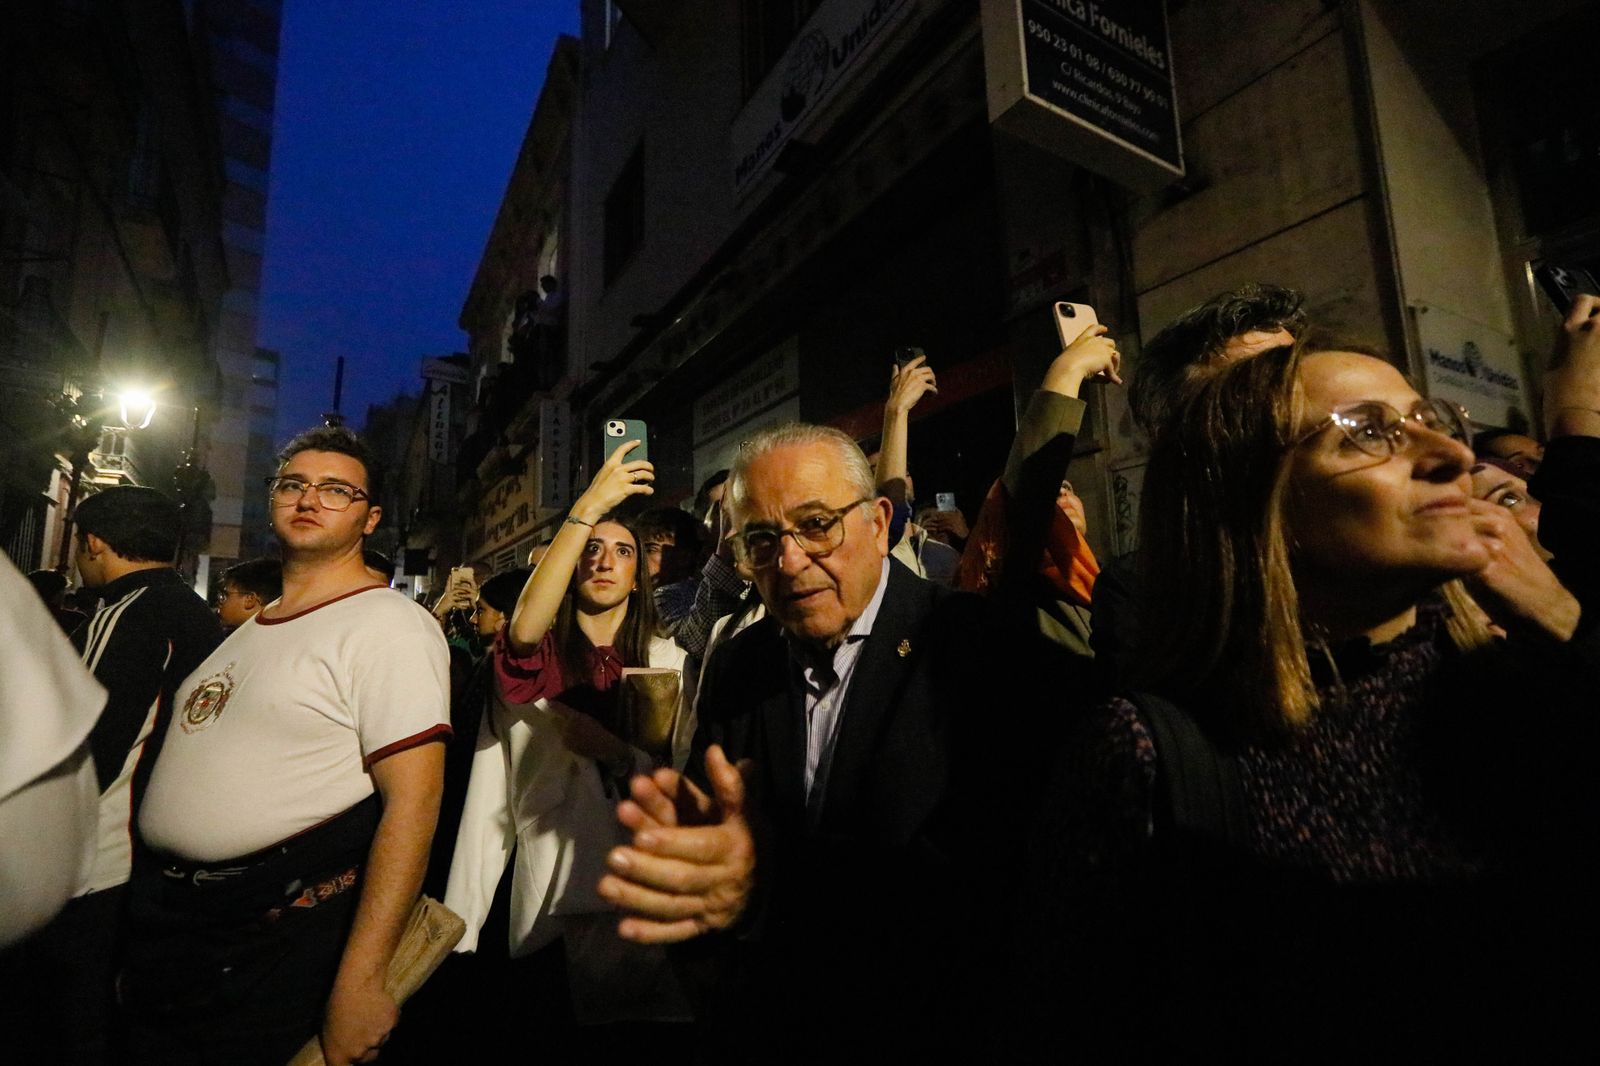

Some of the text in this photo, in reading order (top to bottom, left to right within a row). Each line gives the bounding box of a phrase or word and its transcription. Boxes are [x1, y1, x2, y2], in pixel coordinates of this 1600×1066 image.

[1027, 19, 1051, 43] 950
[1088, 1, 1165, 69] Fornieles
[736, 0, 898, 187] Manos Unida
